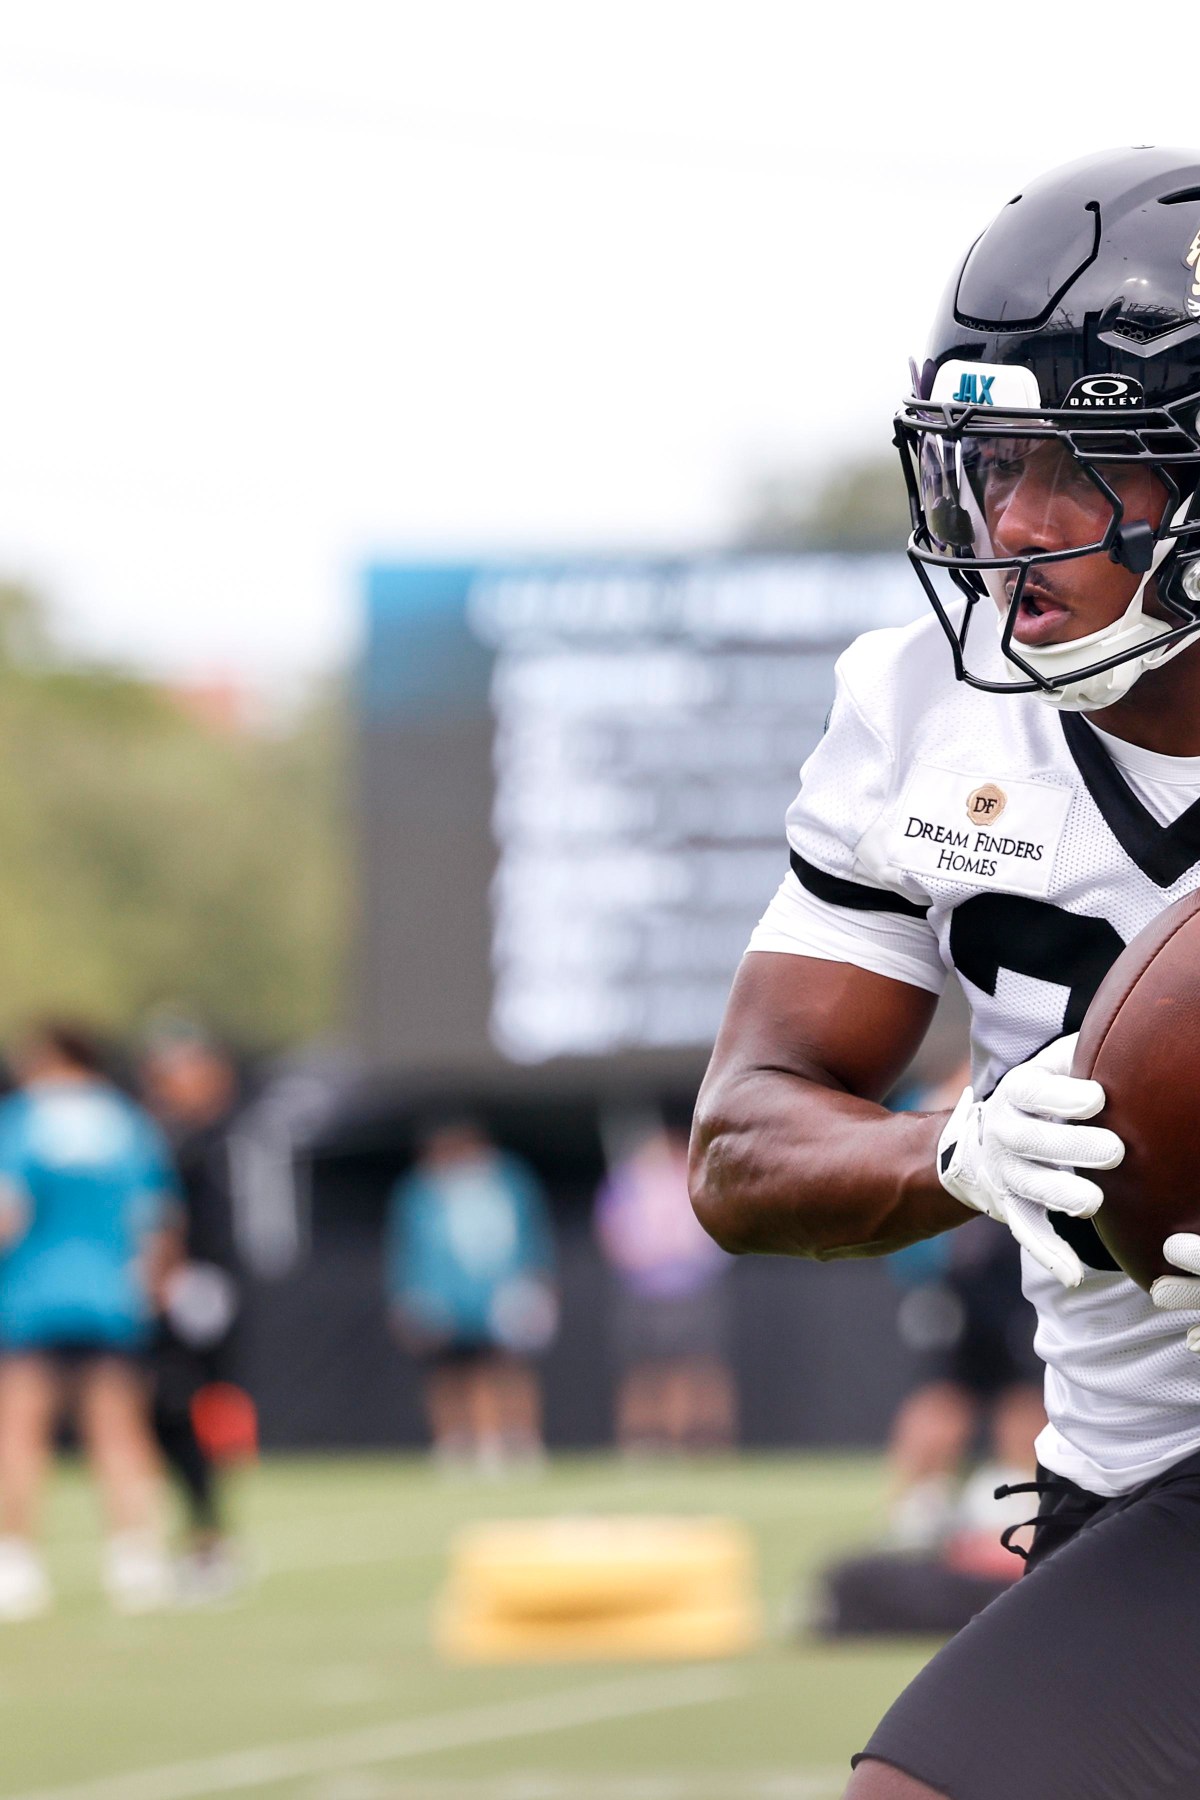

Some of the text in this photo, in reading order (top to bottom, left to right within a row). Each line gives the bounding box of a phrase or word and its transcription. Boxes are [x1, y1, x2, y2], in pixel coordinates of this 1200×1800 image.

[953, 373, 996, 405] JAX
[1070, 396, 1139, 406] OAKLEY
[973, 796, 998, 814] DF
